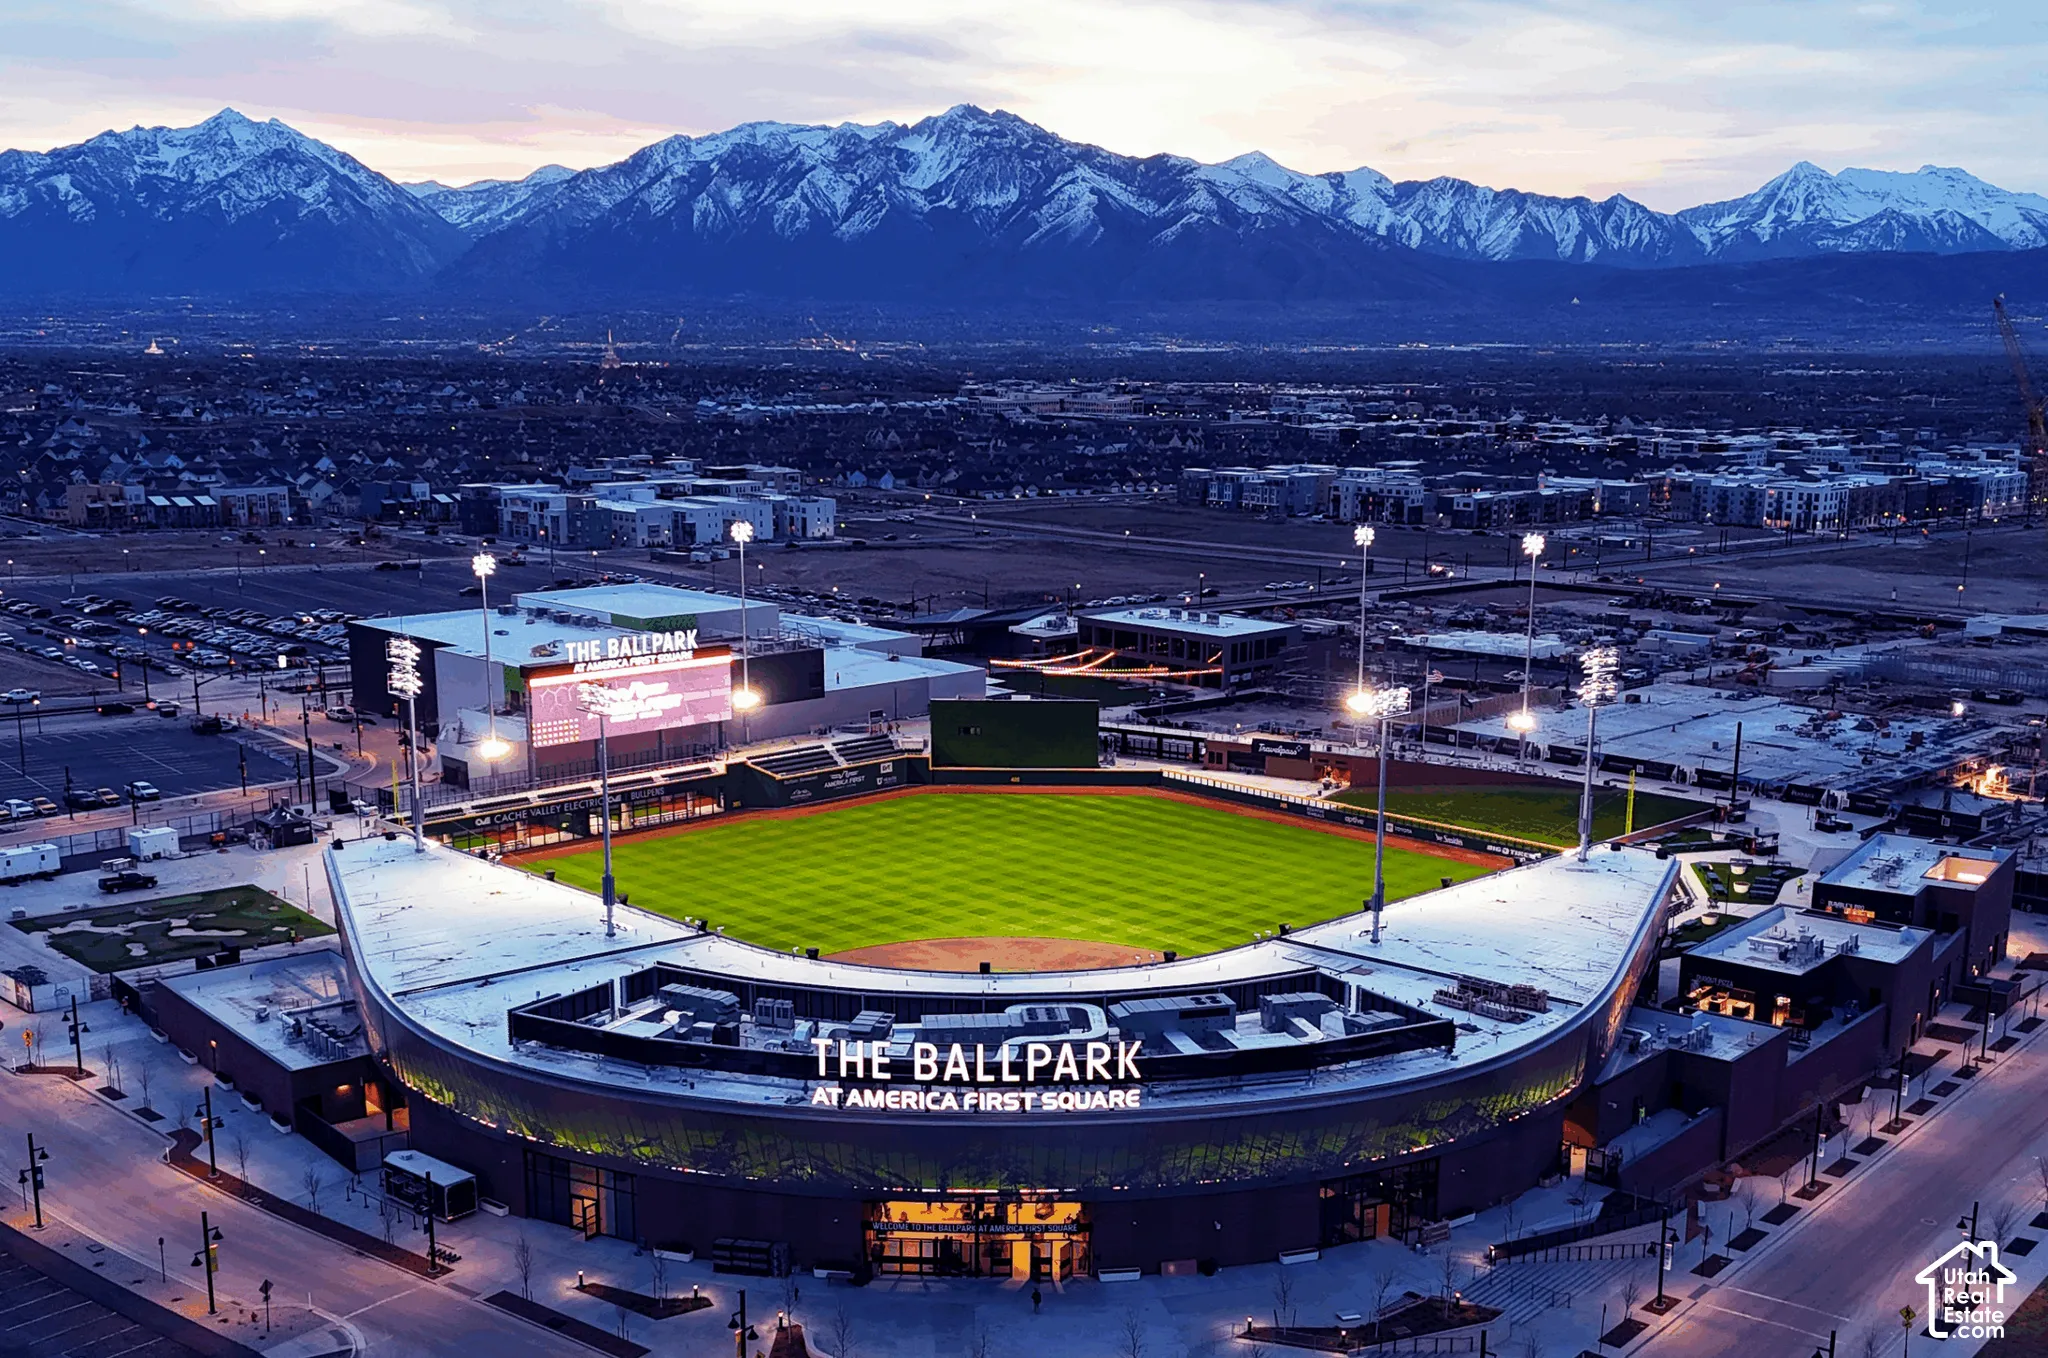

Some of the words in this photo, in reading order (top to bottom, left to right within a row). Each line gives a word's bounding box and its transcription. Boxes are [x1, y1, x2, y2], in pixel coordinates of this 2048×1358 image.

[565, 640, 600, 662] THE
[607, 629, 698, 657] BALLPARK
[573, 663, 586, 672] AT
[587, 657, 629, 671] AMERICA
[629, 655, 656, 666] FIRST
[657, 651, 693, 662] SQUARE
[1258, 743, 1297, 756] Travelpass
[494, 810, 527, 823] CACHE
[530, 804, 561, 817] VALLEY
[564, 798, 604, 811] ELECTRIC
[631, 787, 664, 800] BULLPENS
[1486, 844, 1502, 853] BIG
[811, 1037, 892, 1080] THE
[912, 1041, 1142, 1082] BALLPARK
[811, 1086, 844, 1106] AT
[845, 1088, 959, 1111] AMERICA
[962, 1092, 1038, 1112] FIRST
[1041, 1088, 1142, 1111] SQUARE
[872, 1222, 910, 1231] WELCOME
[938, 1224, 976, 1232] BALLPARK
[978, 1224, 988, 1233] AT
[989, 1224, 1024, 1233] AMERICA
[1025, 1224, 1046, 1232] FIRST
[1048, 1223, 1078, 1232] SQUARE
